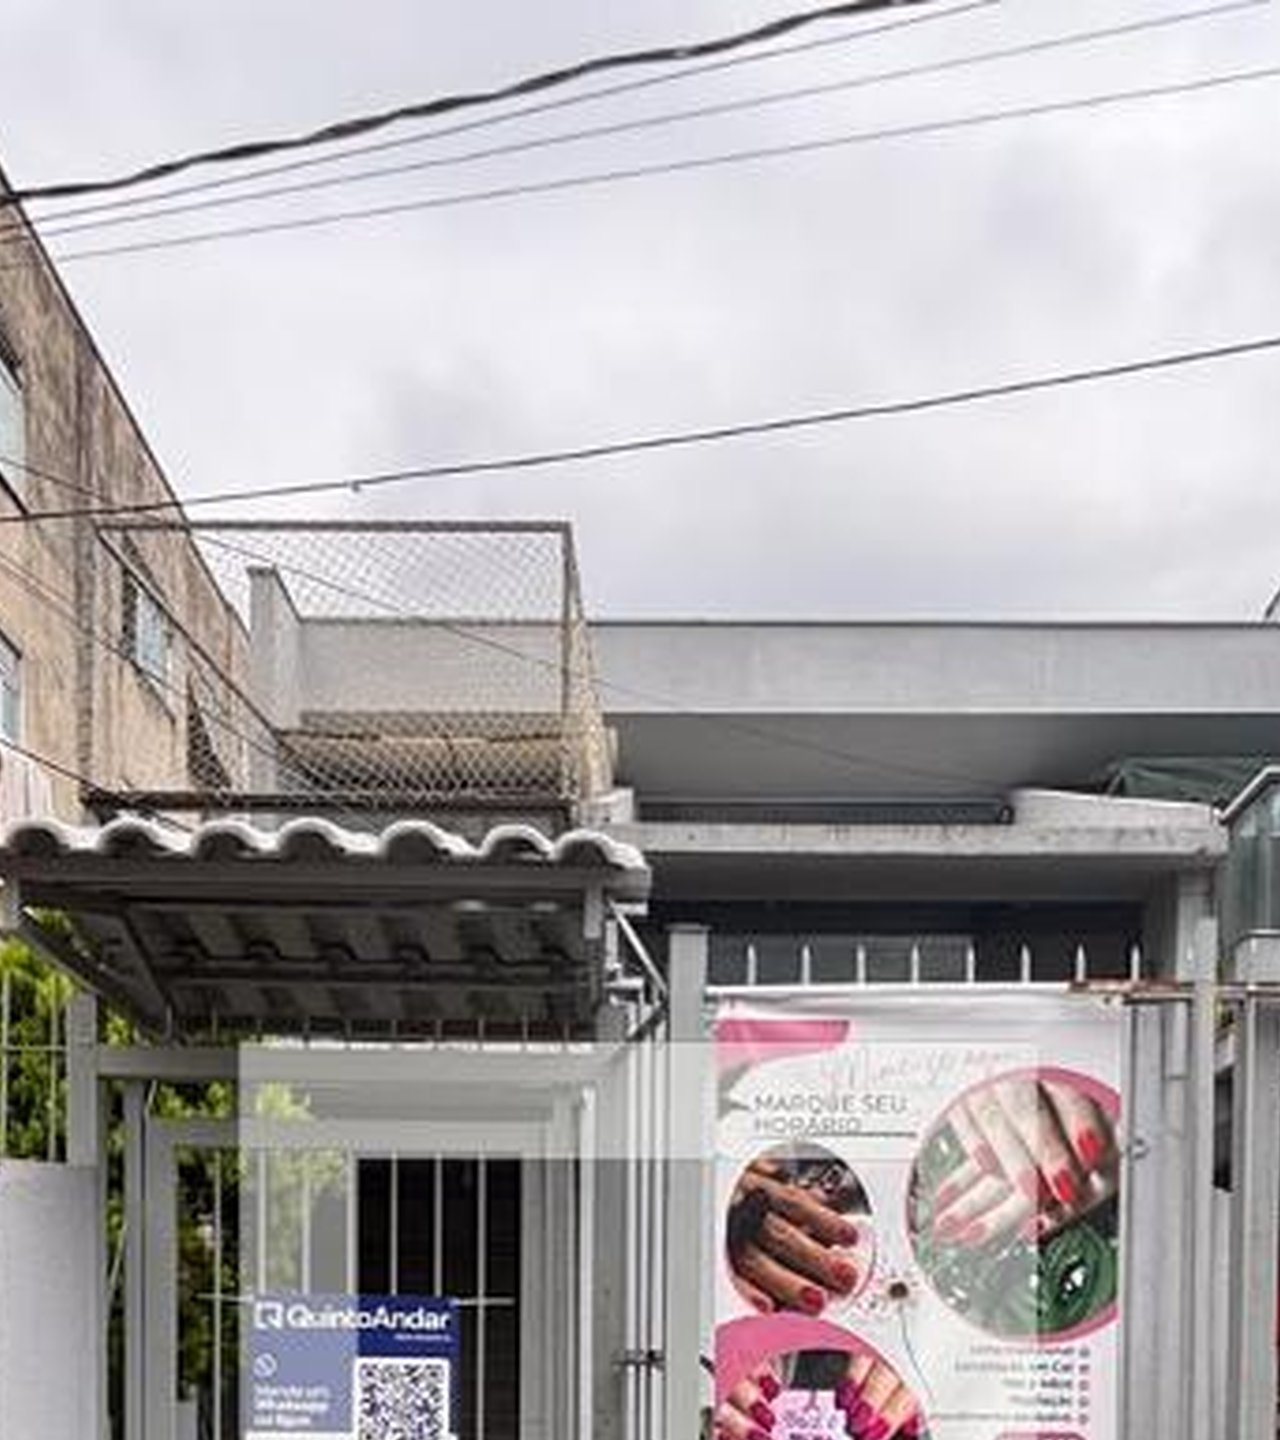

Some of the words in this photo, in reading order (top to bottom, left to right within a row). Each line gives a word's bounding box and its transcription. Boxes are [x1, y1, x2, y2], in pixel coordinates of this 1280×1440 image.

[754, 1094, 852, 1115] MARQUE
[863, 1094, 908, 1115] SEU
[286, 1303, 451, 1330] QuintoAndar
